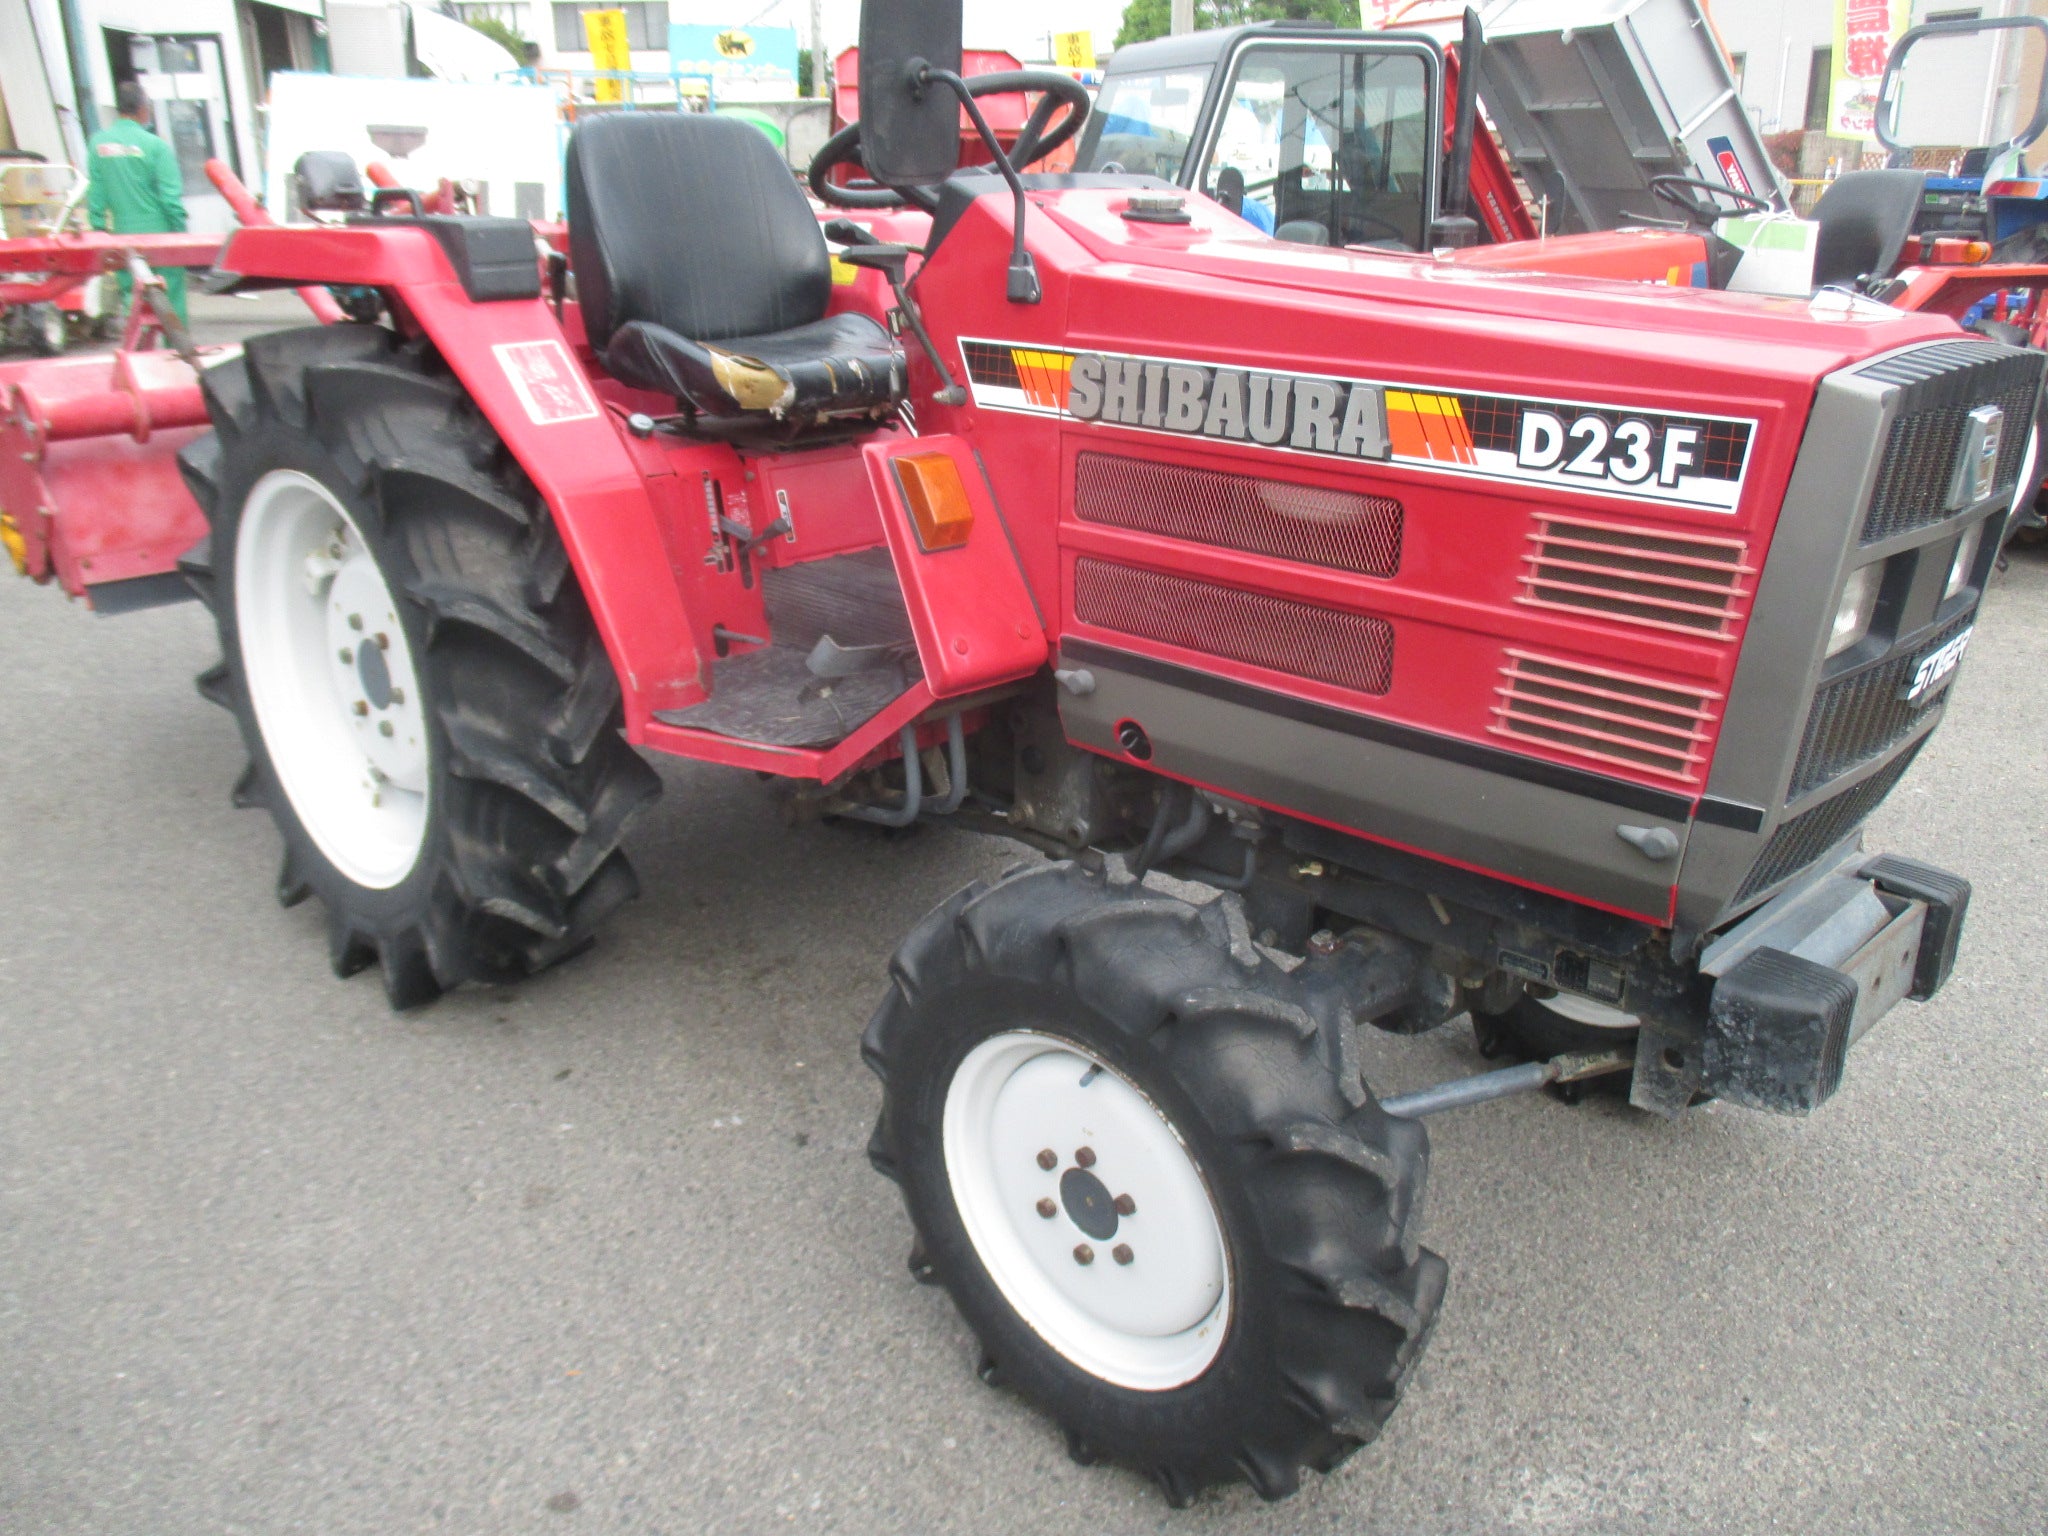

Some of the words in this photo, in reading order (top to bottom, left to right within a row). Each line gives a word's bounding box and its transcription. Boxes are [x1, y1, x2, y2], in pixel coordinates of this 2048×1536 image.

[1486, 191, 1514, 242] YANMAR
[1068, 353, 1392, 461] SHIBAURA
[1516, 409, 1700, 488] D23F
